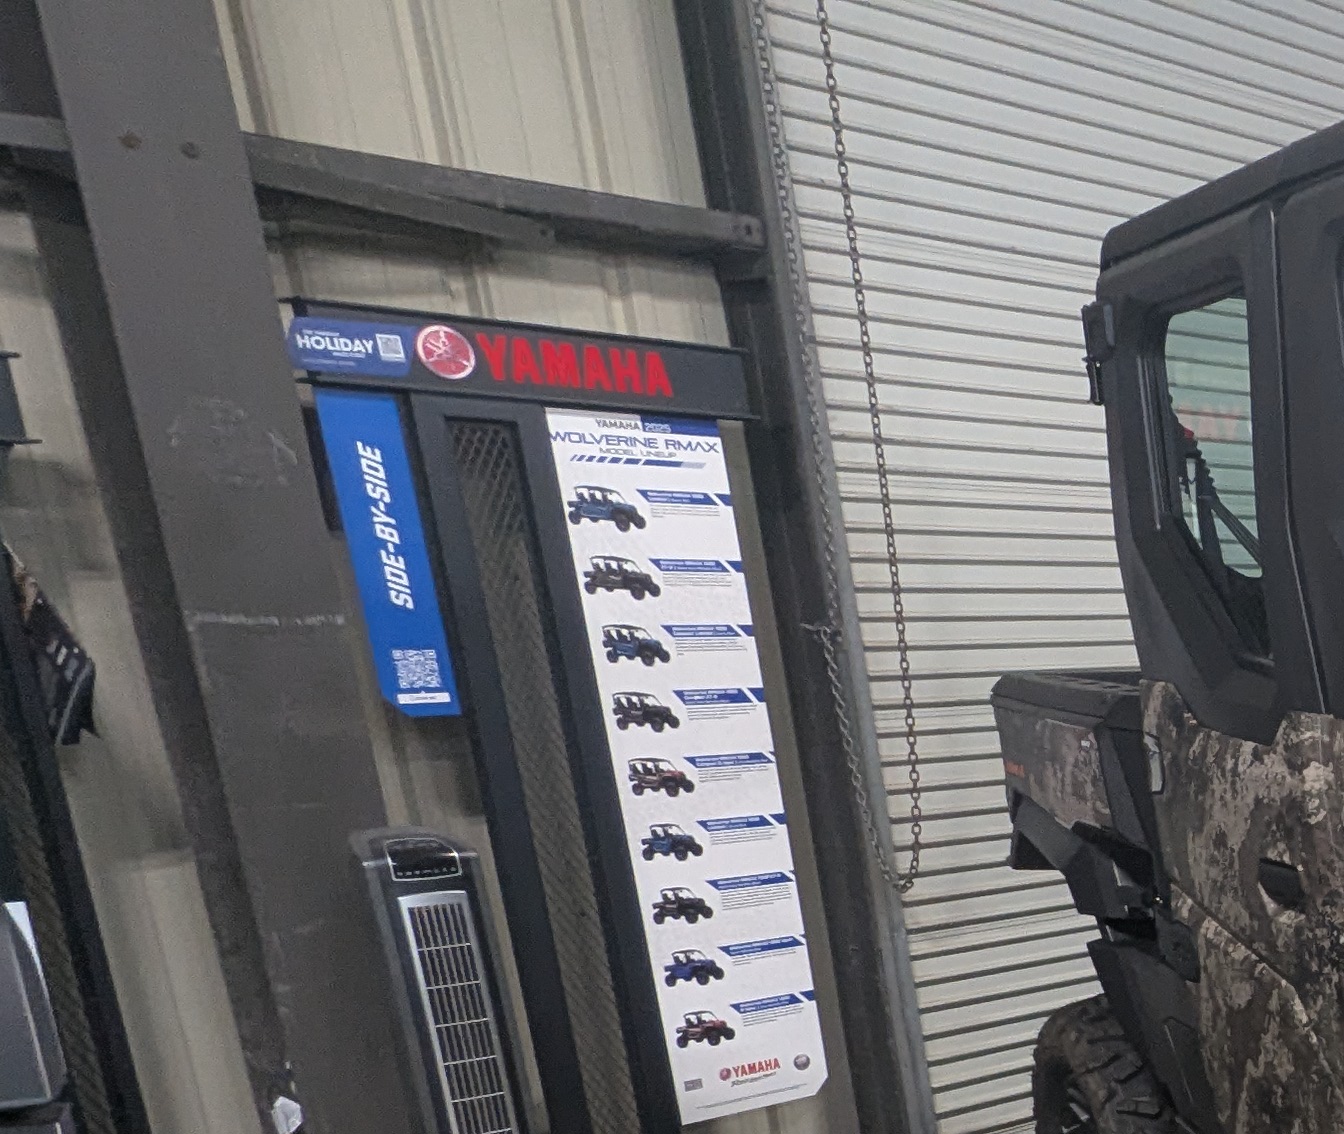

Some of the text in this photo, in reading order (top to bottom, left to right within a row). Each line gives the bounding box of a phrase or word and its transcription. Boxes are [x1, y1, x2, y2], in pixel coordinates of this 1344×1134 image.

[295, 333, 374, 355] HOLIDAY
[475, 332, 674, 398] YAMAHA
[595, 418, 641, 431] YAMAHA
[550, 431, 721, 454] WOLVERINE RMAX
[356, 440, 415, 610] SIDE-BY-SIDE
[732, 1057, 781, 1078] YAMAHA
